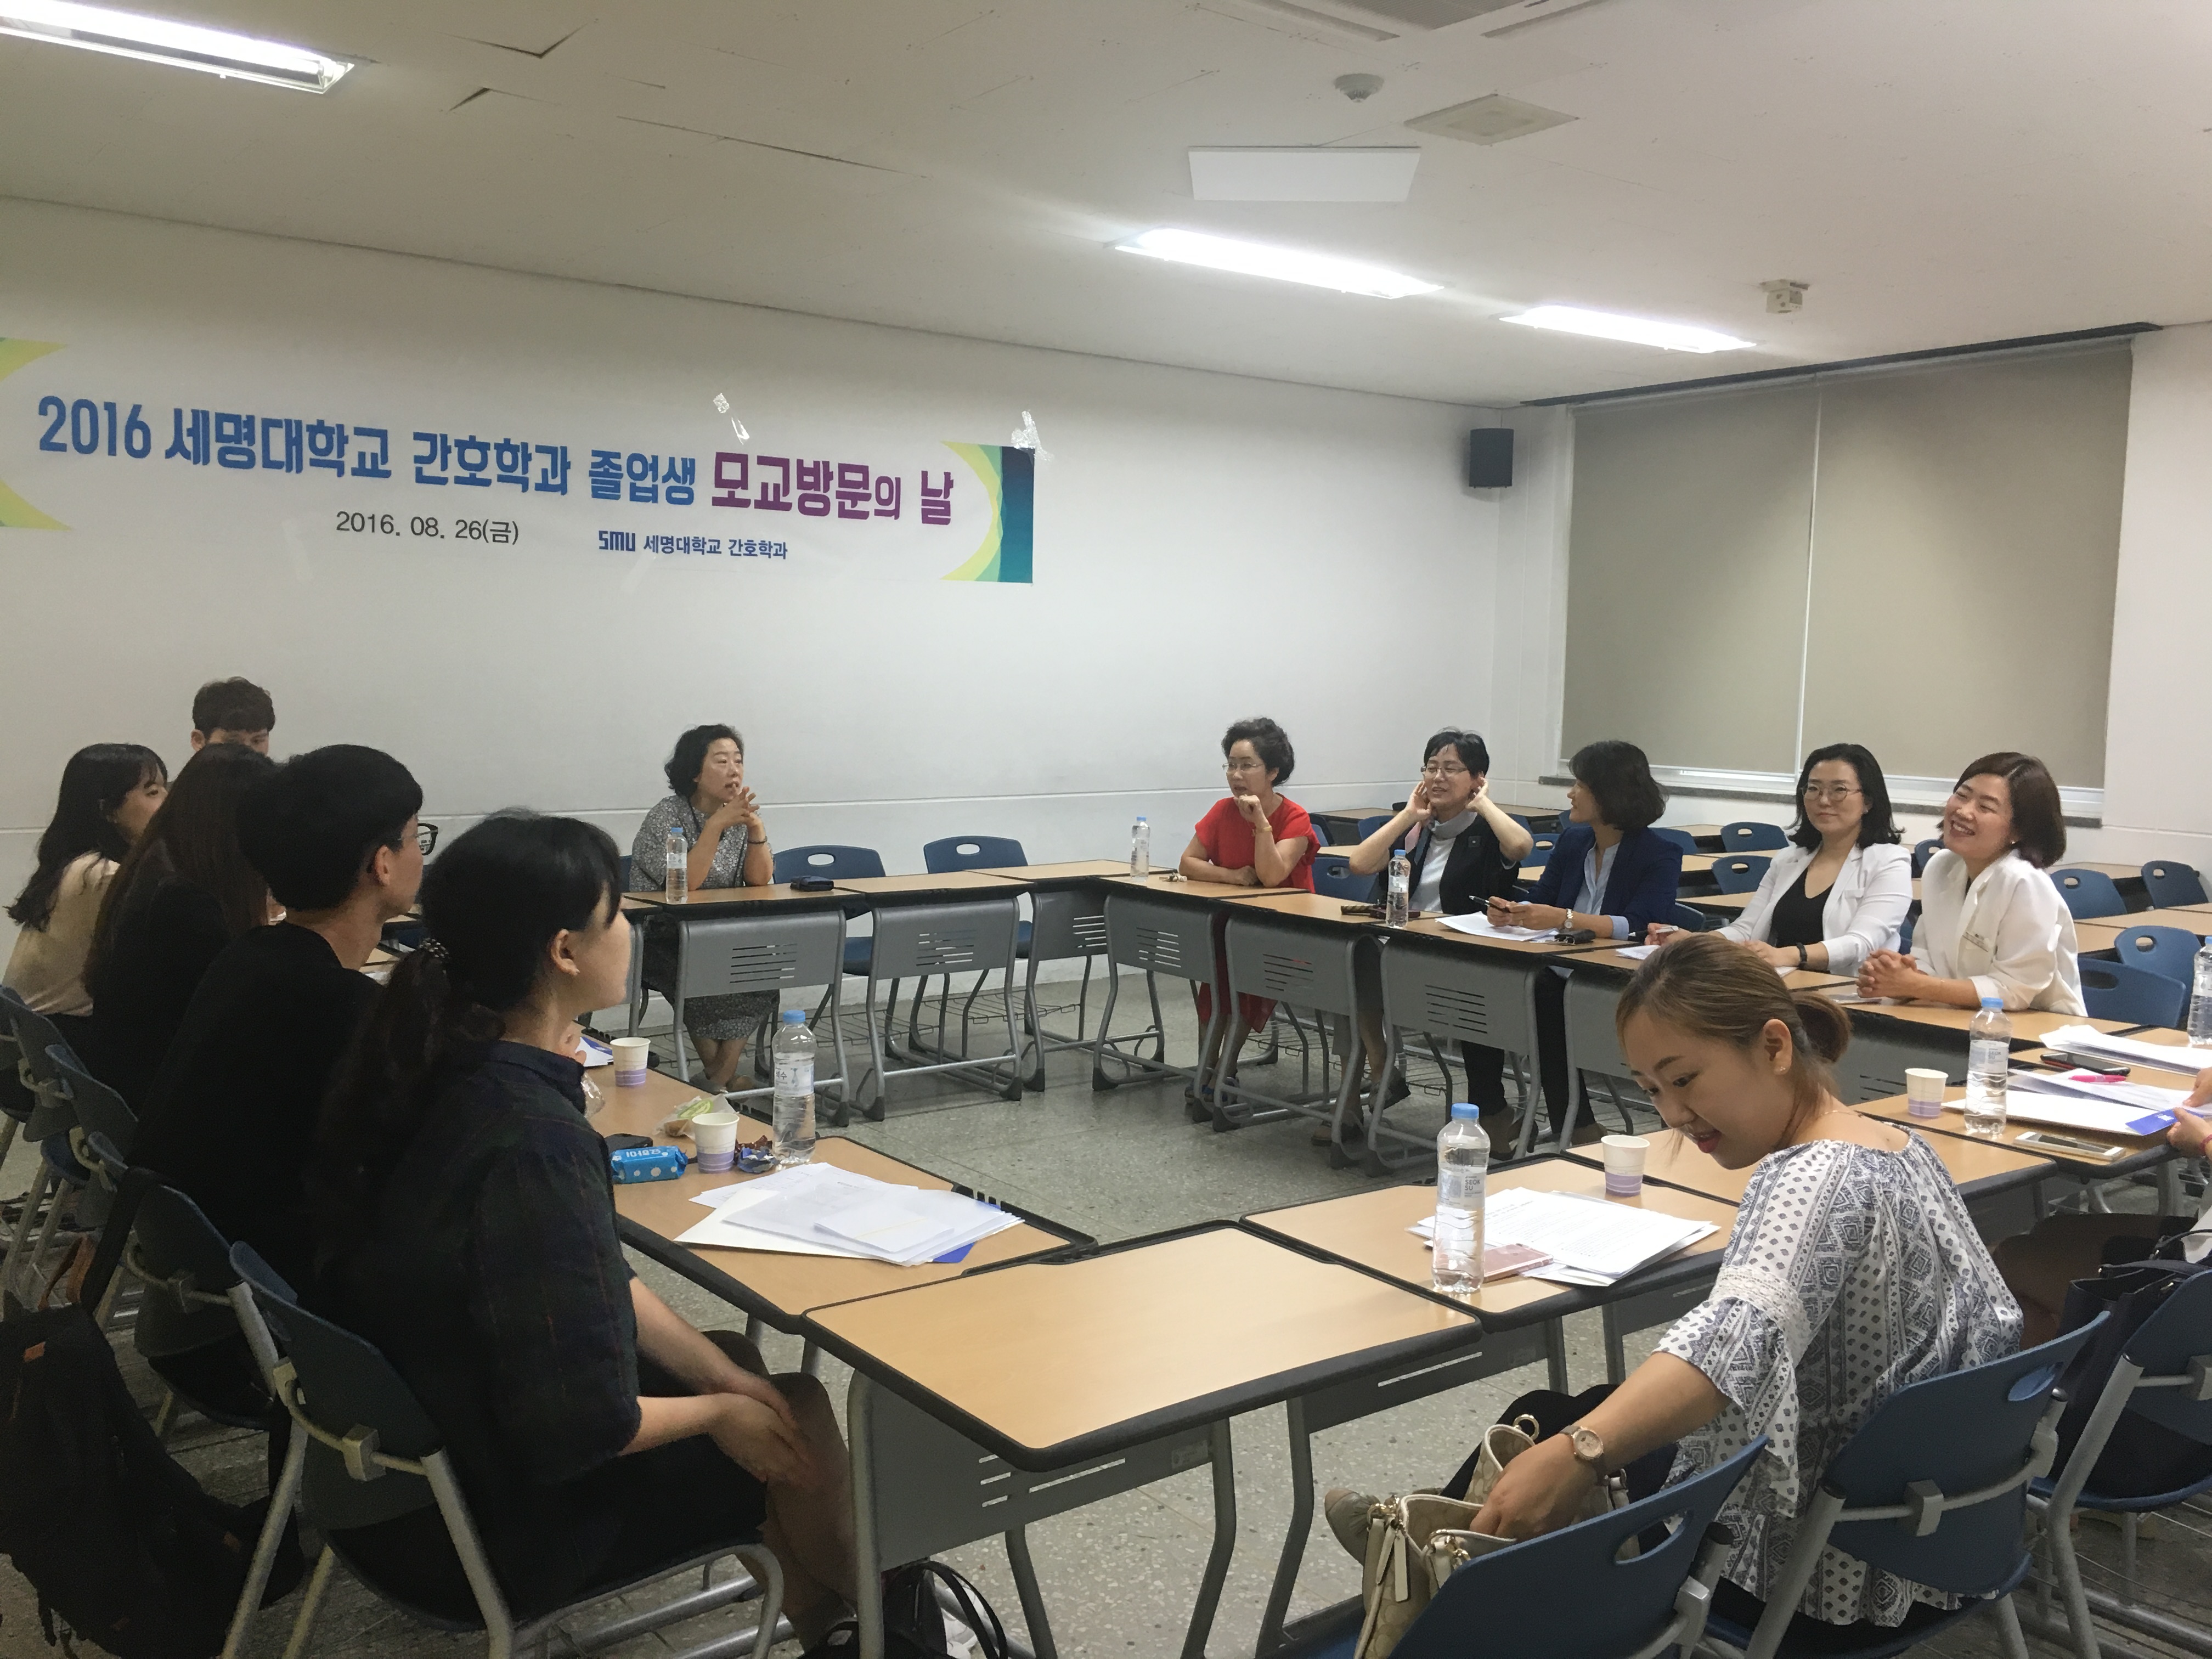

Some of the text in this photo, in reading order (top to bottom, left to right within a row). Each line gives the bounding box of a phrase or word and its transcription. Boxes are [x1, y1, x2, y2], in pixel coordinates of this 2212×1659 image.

[38, 396, 953, 525] 2016 세명대학교 간호학과 졸업생 모교방문의 날
[336, 511, 519, 545] 2016. 08. 26(금)
[644, 535, 722, 555] 세명대학교
[728, 539, 788, 560] 간호학과
